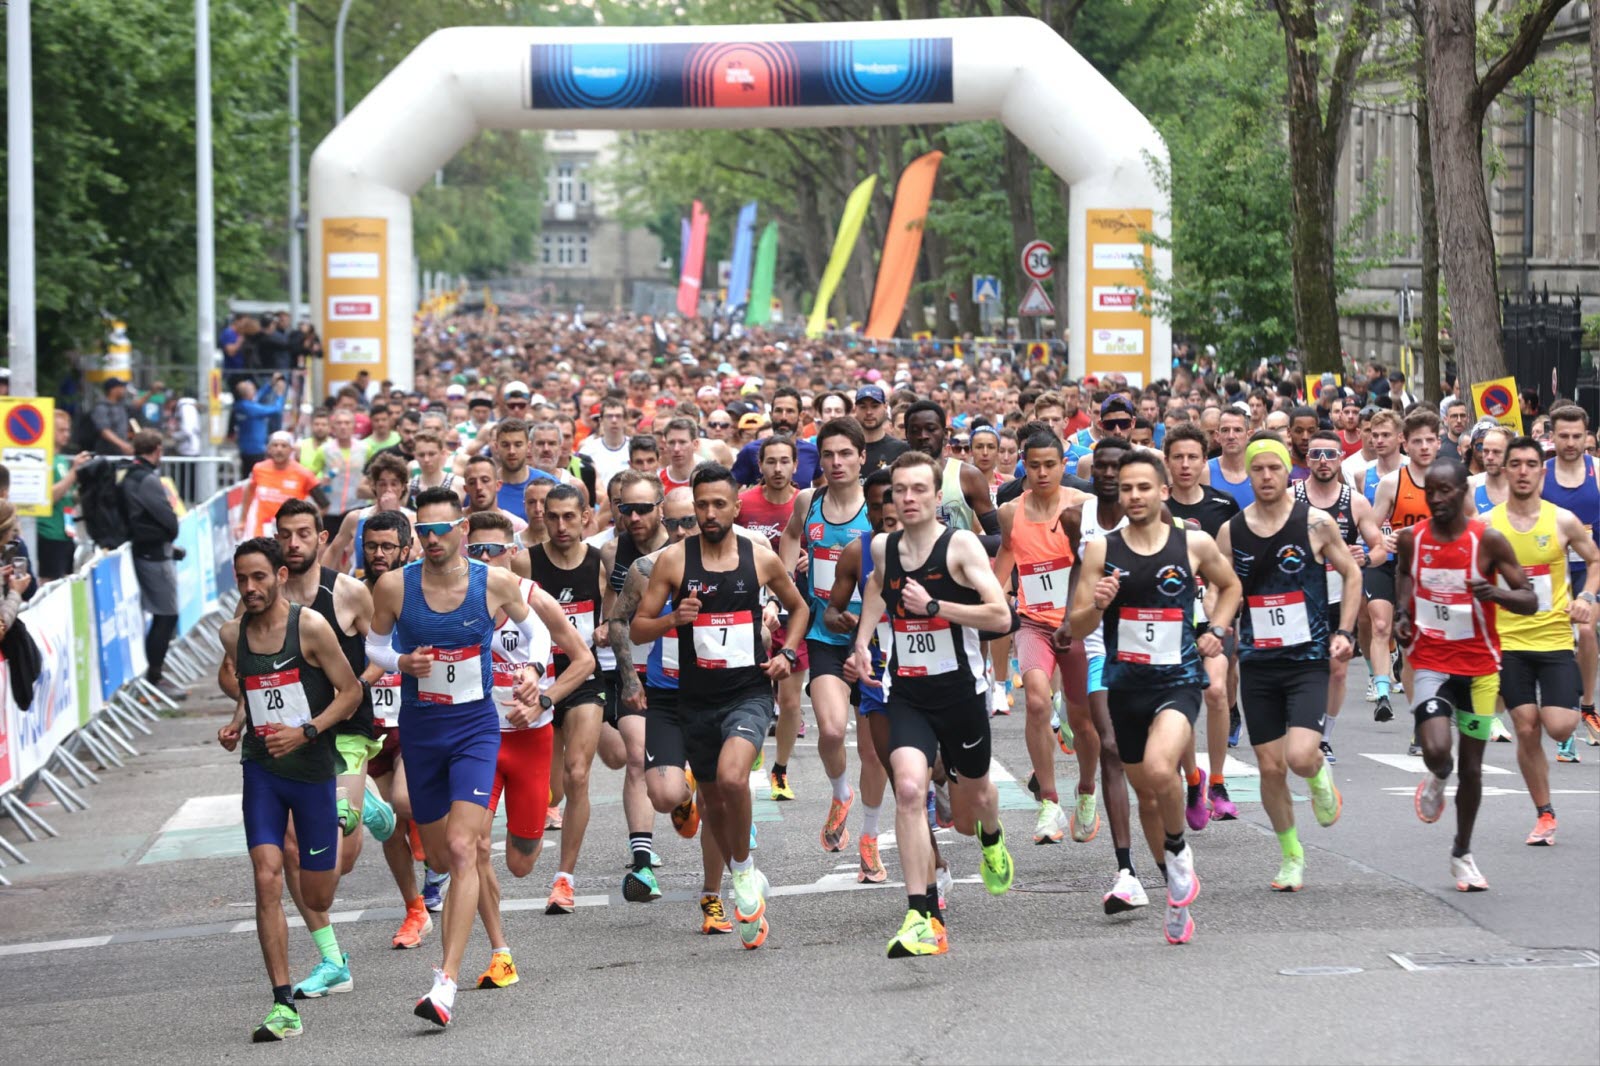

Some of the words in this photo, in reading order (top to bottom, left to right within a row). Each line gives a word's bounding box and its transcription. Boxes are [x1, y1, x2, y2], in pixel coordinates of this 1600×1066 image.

[1030, 253, 1052, 268] 30
[1039, 573, 1053, 591] 11
[1268, 608, 1286, 626] 16
[1434, 604, 1450, 621] 18
[719, 627, 728, 646] 7
[1145, 623, 1154, 642] 5
[907, 632, 936, 653] 280
[439, 653, 454, 661] DNA
[446, 664, 456, 683] 8
[260, 679, 273, 687] DNA
[264, 688, 285, 711] 28
[375, 688, 393, 706] 20
